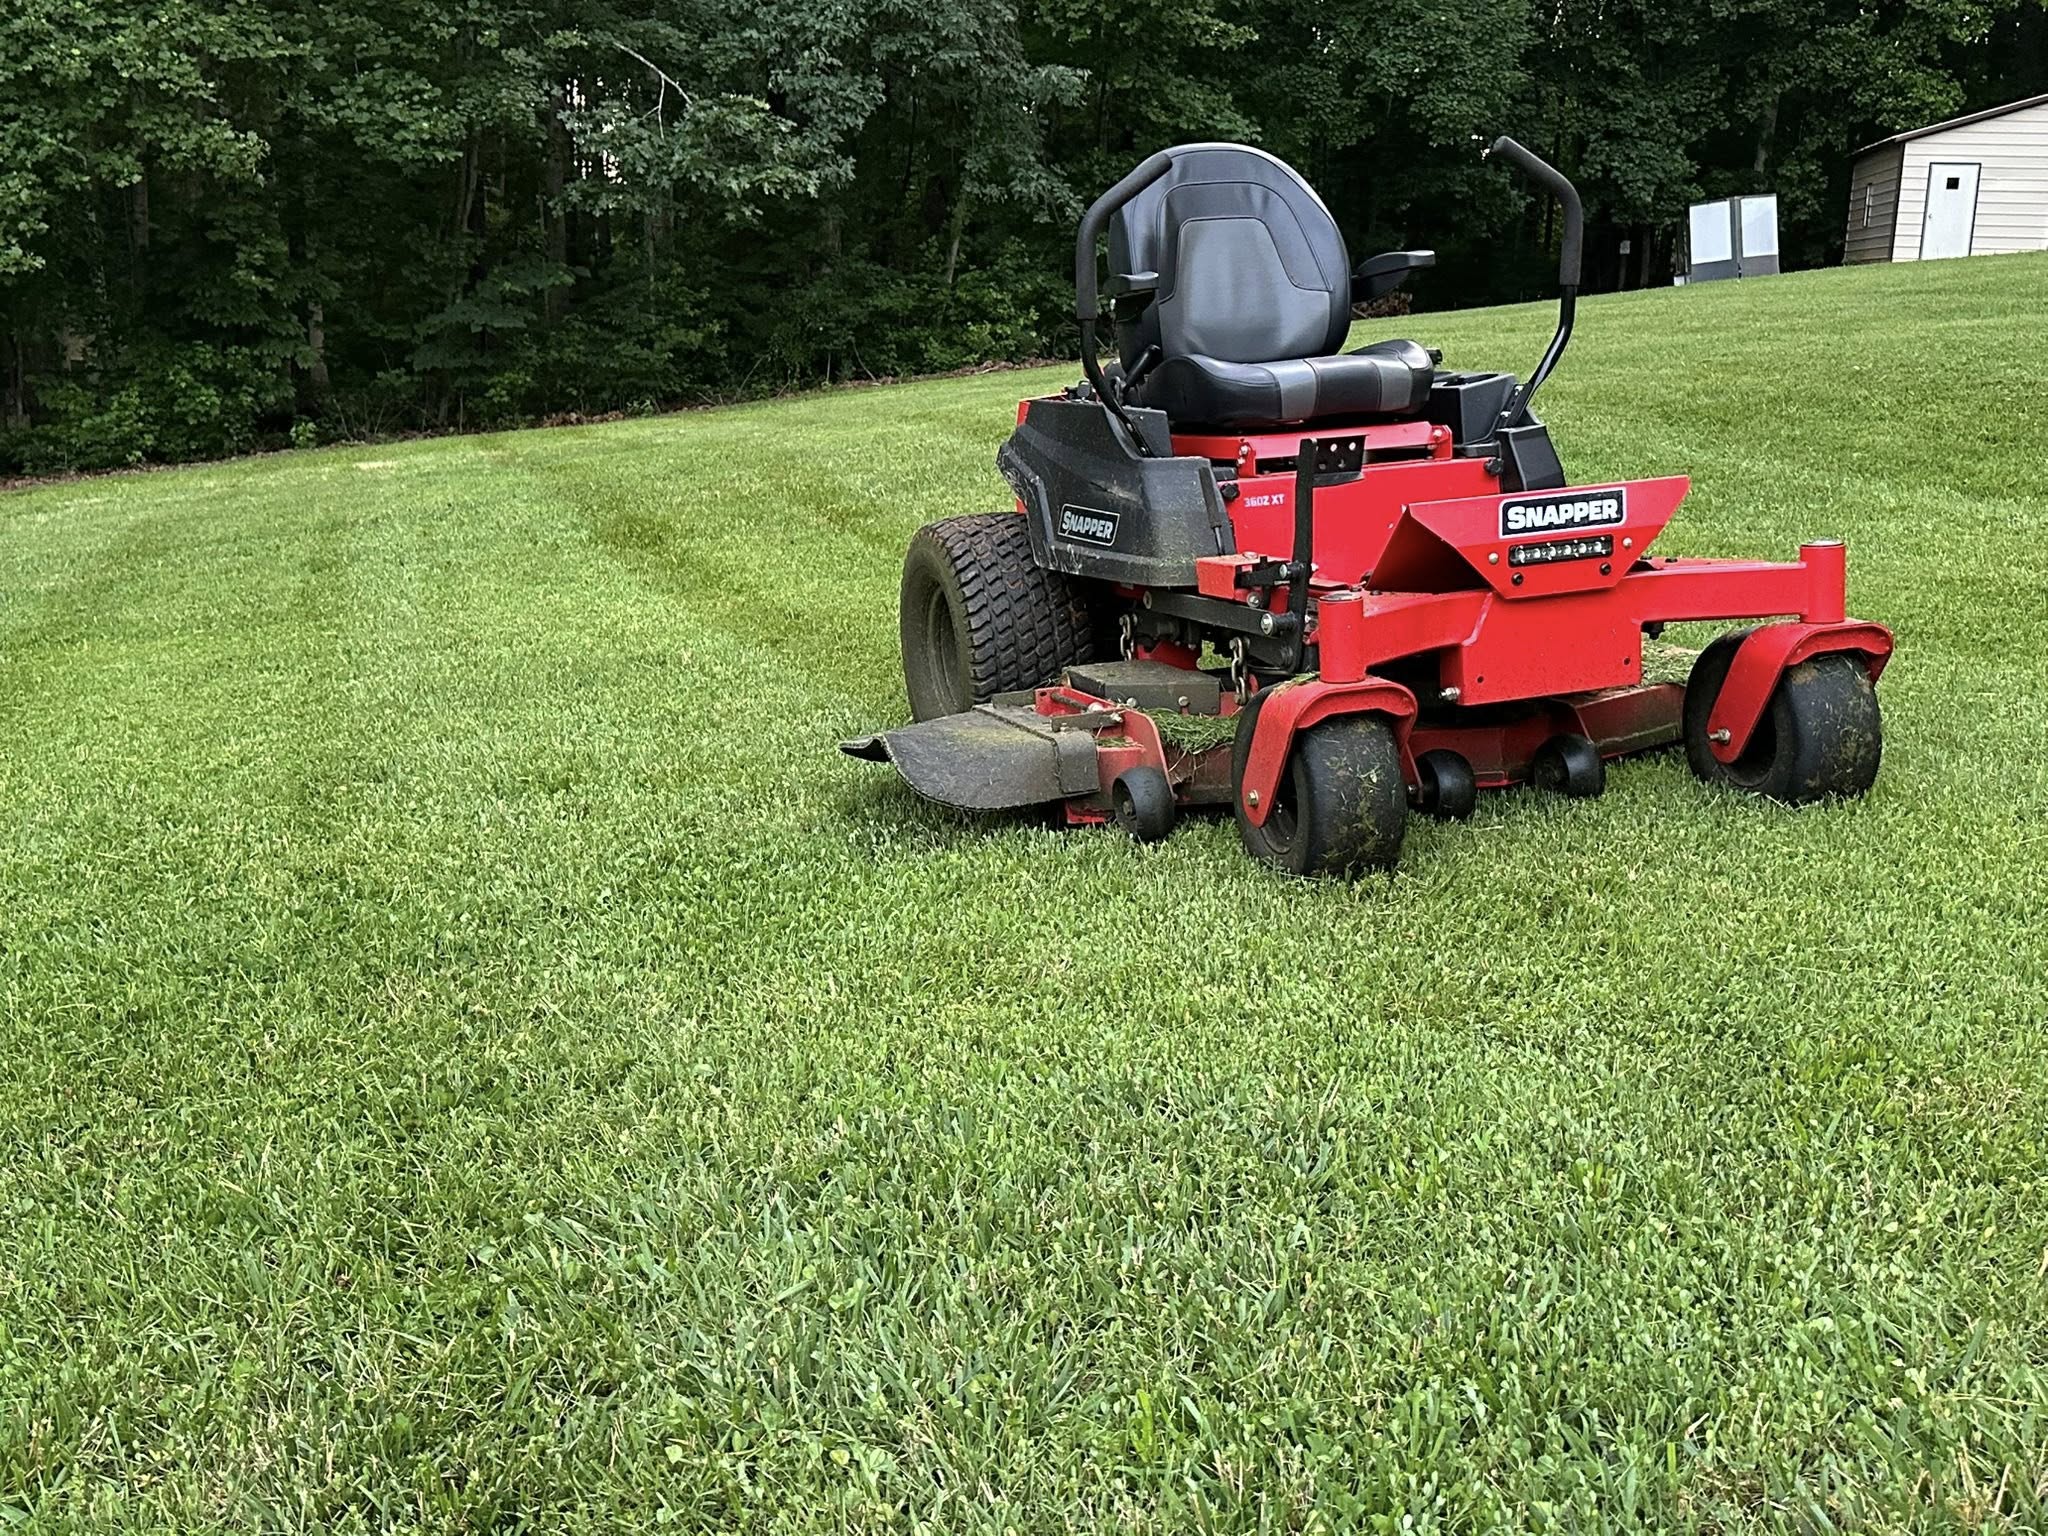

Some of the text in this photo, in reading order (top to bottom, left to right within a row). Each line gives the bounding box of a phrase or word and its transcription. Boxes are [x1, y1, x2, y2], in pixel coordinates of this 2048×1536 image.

[1271, 494, 1285, 505] XT
[1507, 499, 1618, 529] SNAPPER
[1062, 510, 1114, 539] SNAPPER
